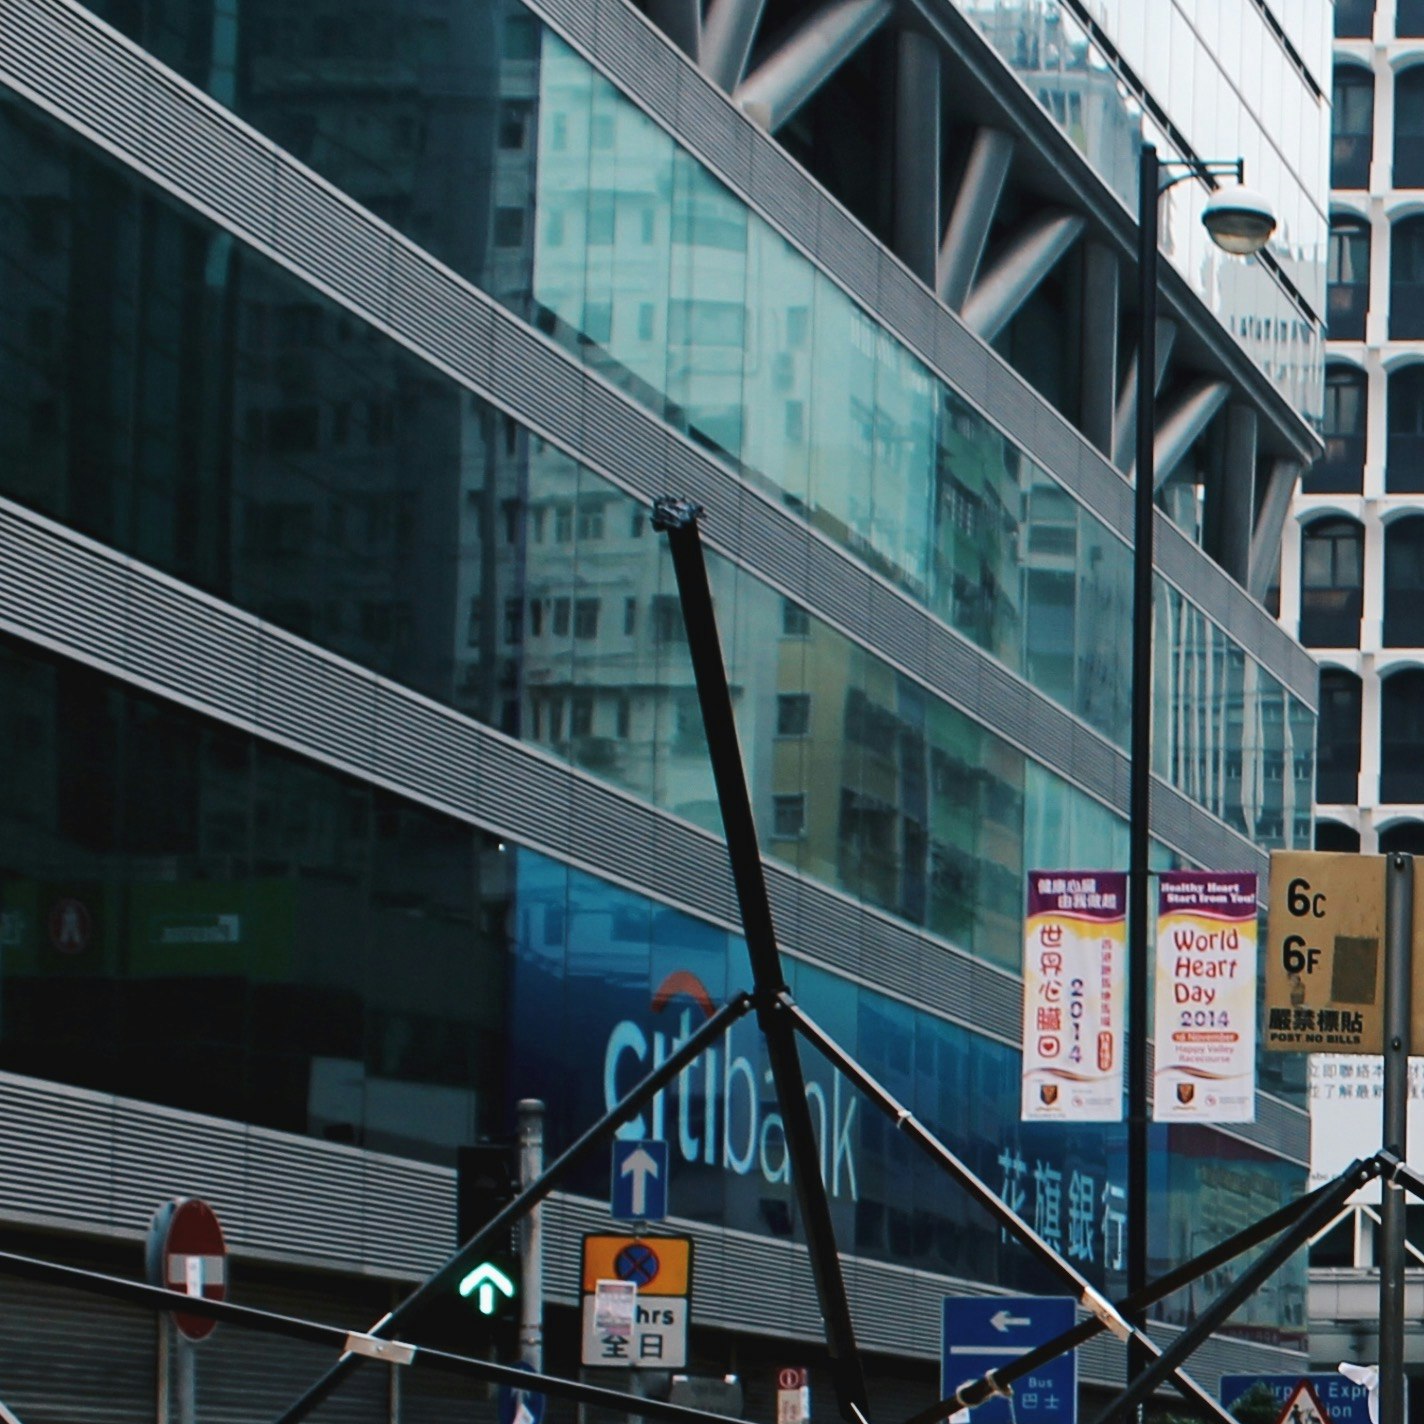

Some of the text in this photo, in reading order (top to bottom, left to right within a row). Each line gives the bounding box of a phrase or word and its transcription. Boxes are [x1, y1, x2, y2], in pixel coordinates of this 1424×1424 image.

[1287, 878, 1327, 918] 6C
[1174, 929, 1239, 951] World
[1282, 935, 1322, 974] 6F
[1175, 956, 1237, 979] Heart
[1174, 982, 1215, 1005] Day
[1181, 1010, 1230, 1027] 2014
[1269, 1008, 1363, 1034] 嚴禁標貼
[1271, 1033, 1361, 1044] POST NO BILLS
[604, 1007, 858, 1201] citibank
[998, 1146, 1127, 1271] 花旗銀行
[636, 1305, 675, 1325] hrs
[601, 1334, 664, 1359] 全日
[1028, 1377, 1053, 1388] Bus
[1022, 1394, 1060, 1409] 巴士
